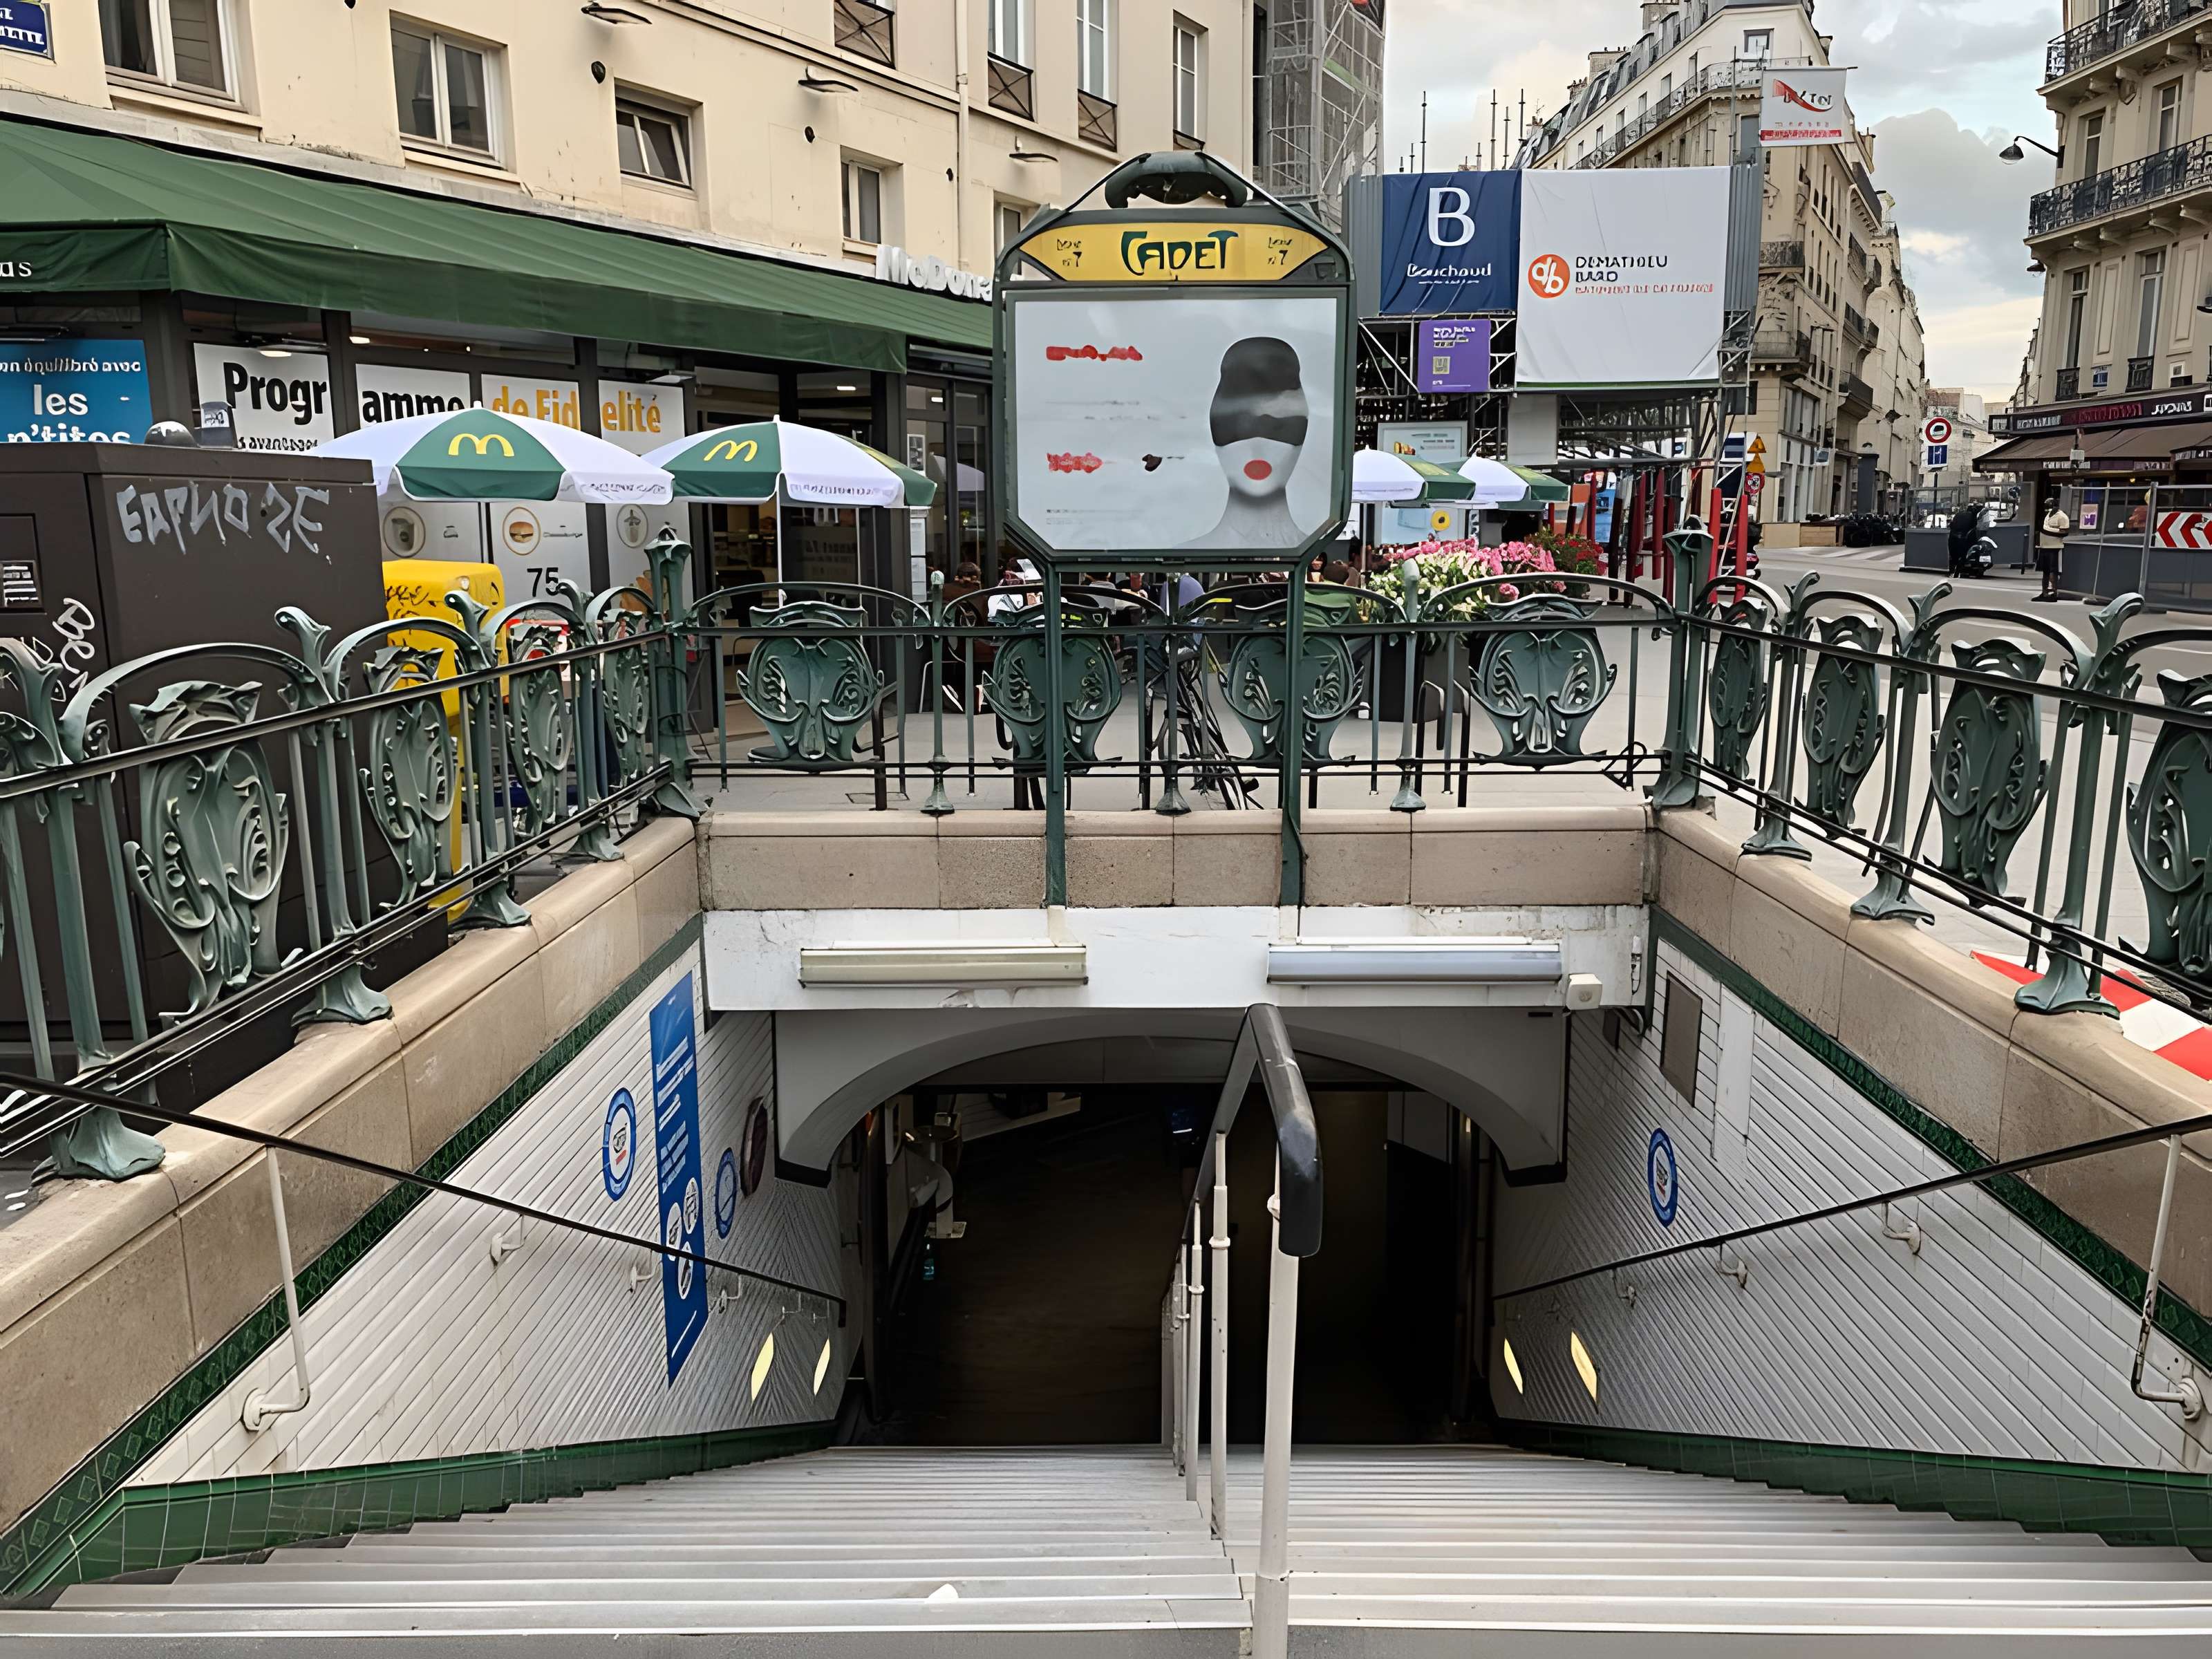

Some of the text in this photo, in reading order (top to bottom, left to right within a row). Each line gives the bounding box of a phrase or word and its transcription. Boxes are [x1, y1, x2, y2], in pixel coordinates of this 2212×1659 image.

[1428, 187, 1475, 247] B
[1121, 230, 1239, 276] CADET
[33, 384, 89, 415] les
[527, 567, 559, 597] 75
